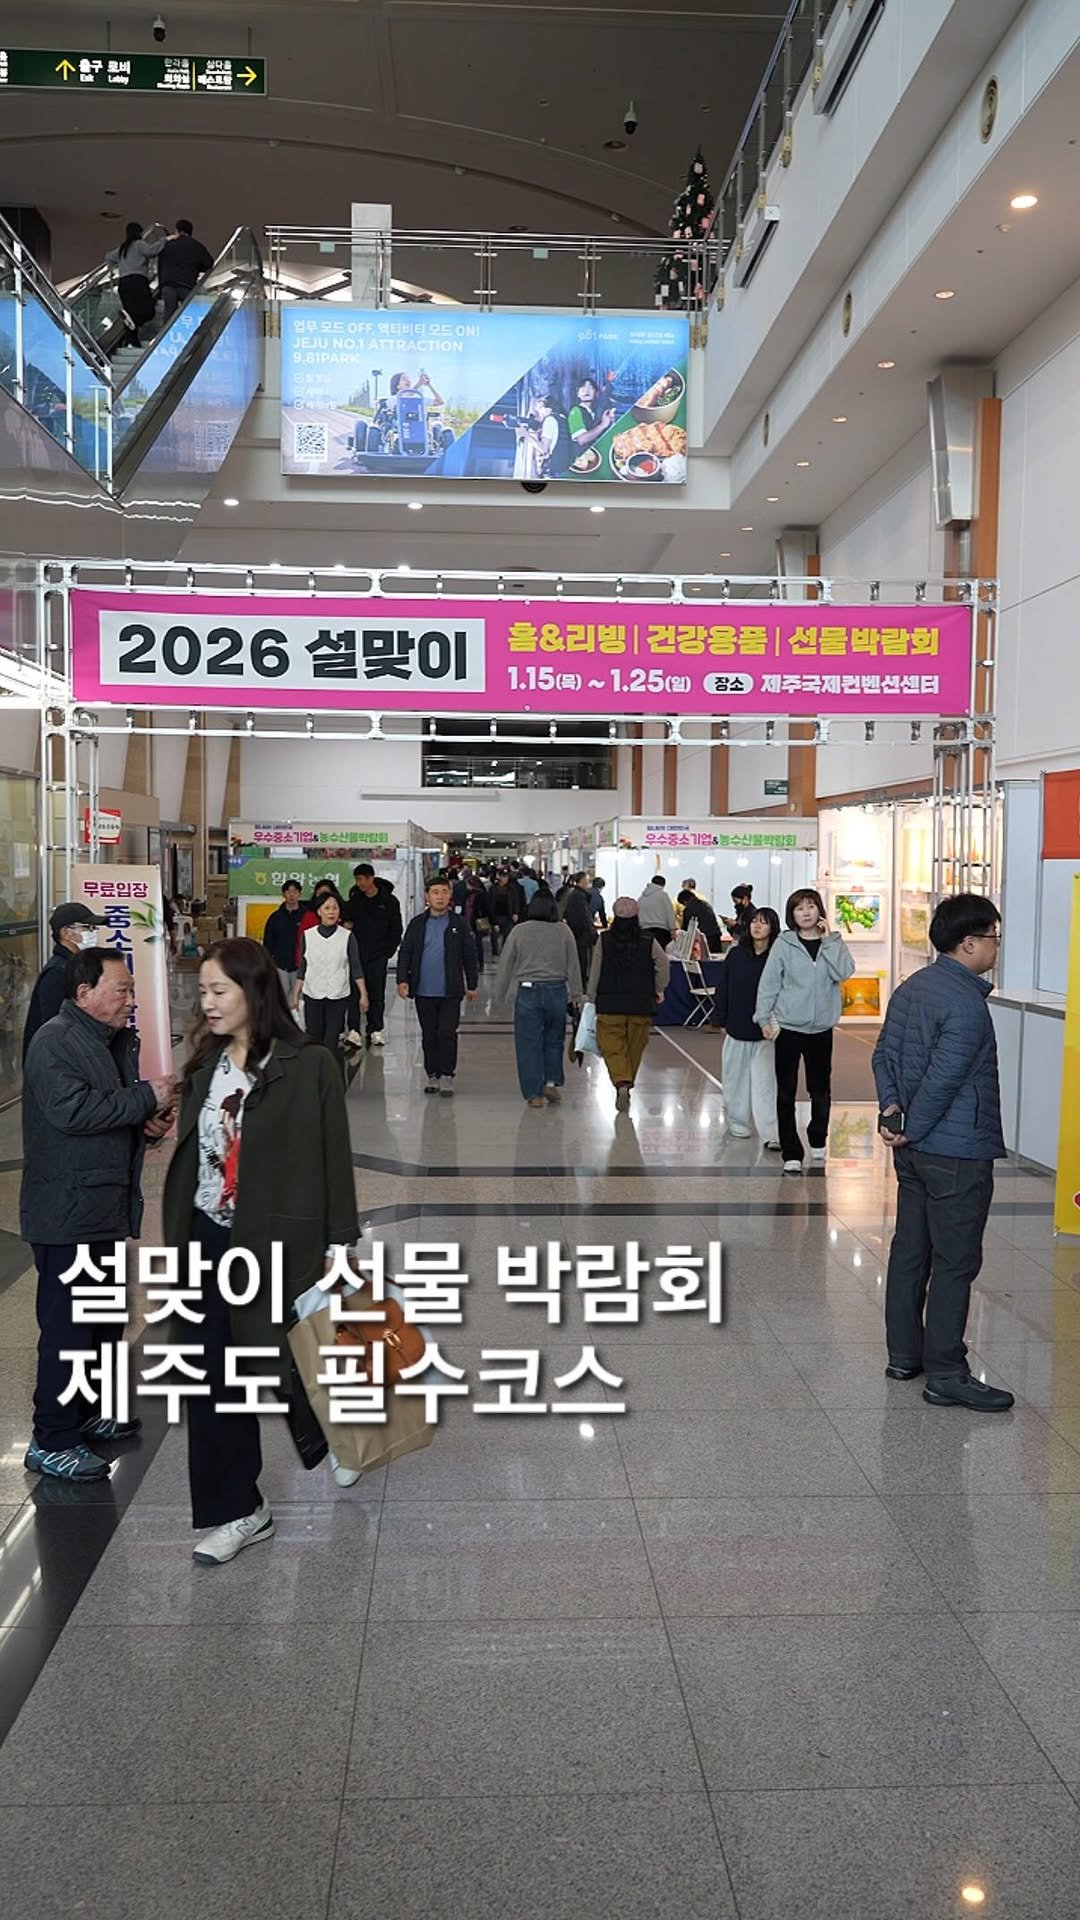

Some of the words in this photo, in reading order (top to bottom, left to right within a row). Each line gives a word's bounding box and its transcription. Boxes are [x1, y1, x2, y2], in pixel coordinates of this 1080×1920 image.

[79, 58, 103, 73] 출구
[107, 60, 131, 74] 로비
[294, 320, 317, 333] 업무
[320, 321, 344, 333] 모드
[378, 322, 425, 336] 액티비티
[429, 324, 453, 336] 모드
[456, 325, 480, 336] ON!
[292, 337, 328, 349] JEJU
[333, 338, 364, 350] NO.1
[368, 339, 464, 352] ATTRACTION
[292, 351, 360, 364] 9.81PARK
[508, 621, 626, 655] 홈&리빙
[647, 624, 769, 656] 건강용품
[788, 625, 940, 657] 선물박람회
[118, 623, 290, 678] 2026
[305, 628, 468, 681] 설맞이
[507, 666, 582, 692] 1.15(목)
[610, 667, 692, 693] 1.25(일)
[714, 676, 745, 692] 장소
[761, 674, 940, 695] 제주국제컨벤션센터
[83, 881, 149, 898] 무료입장
